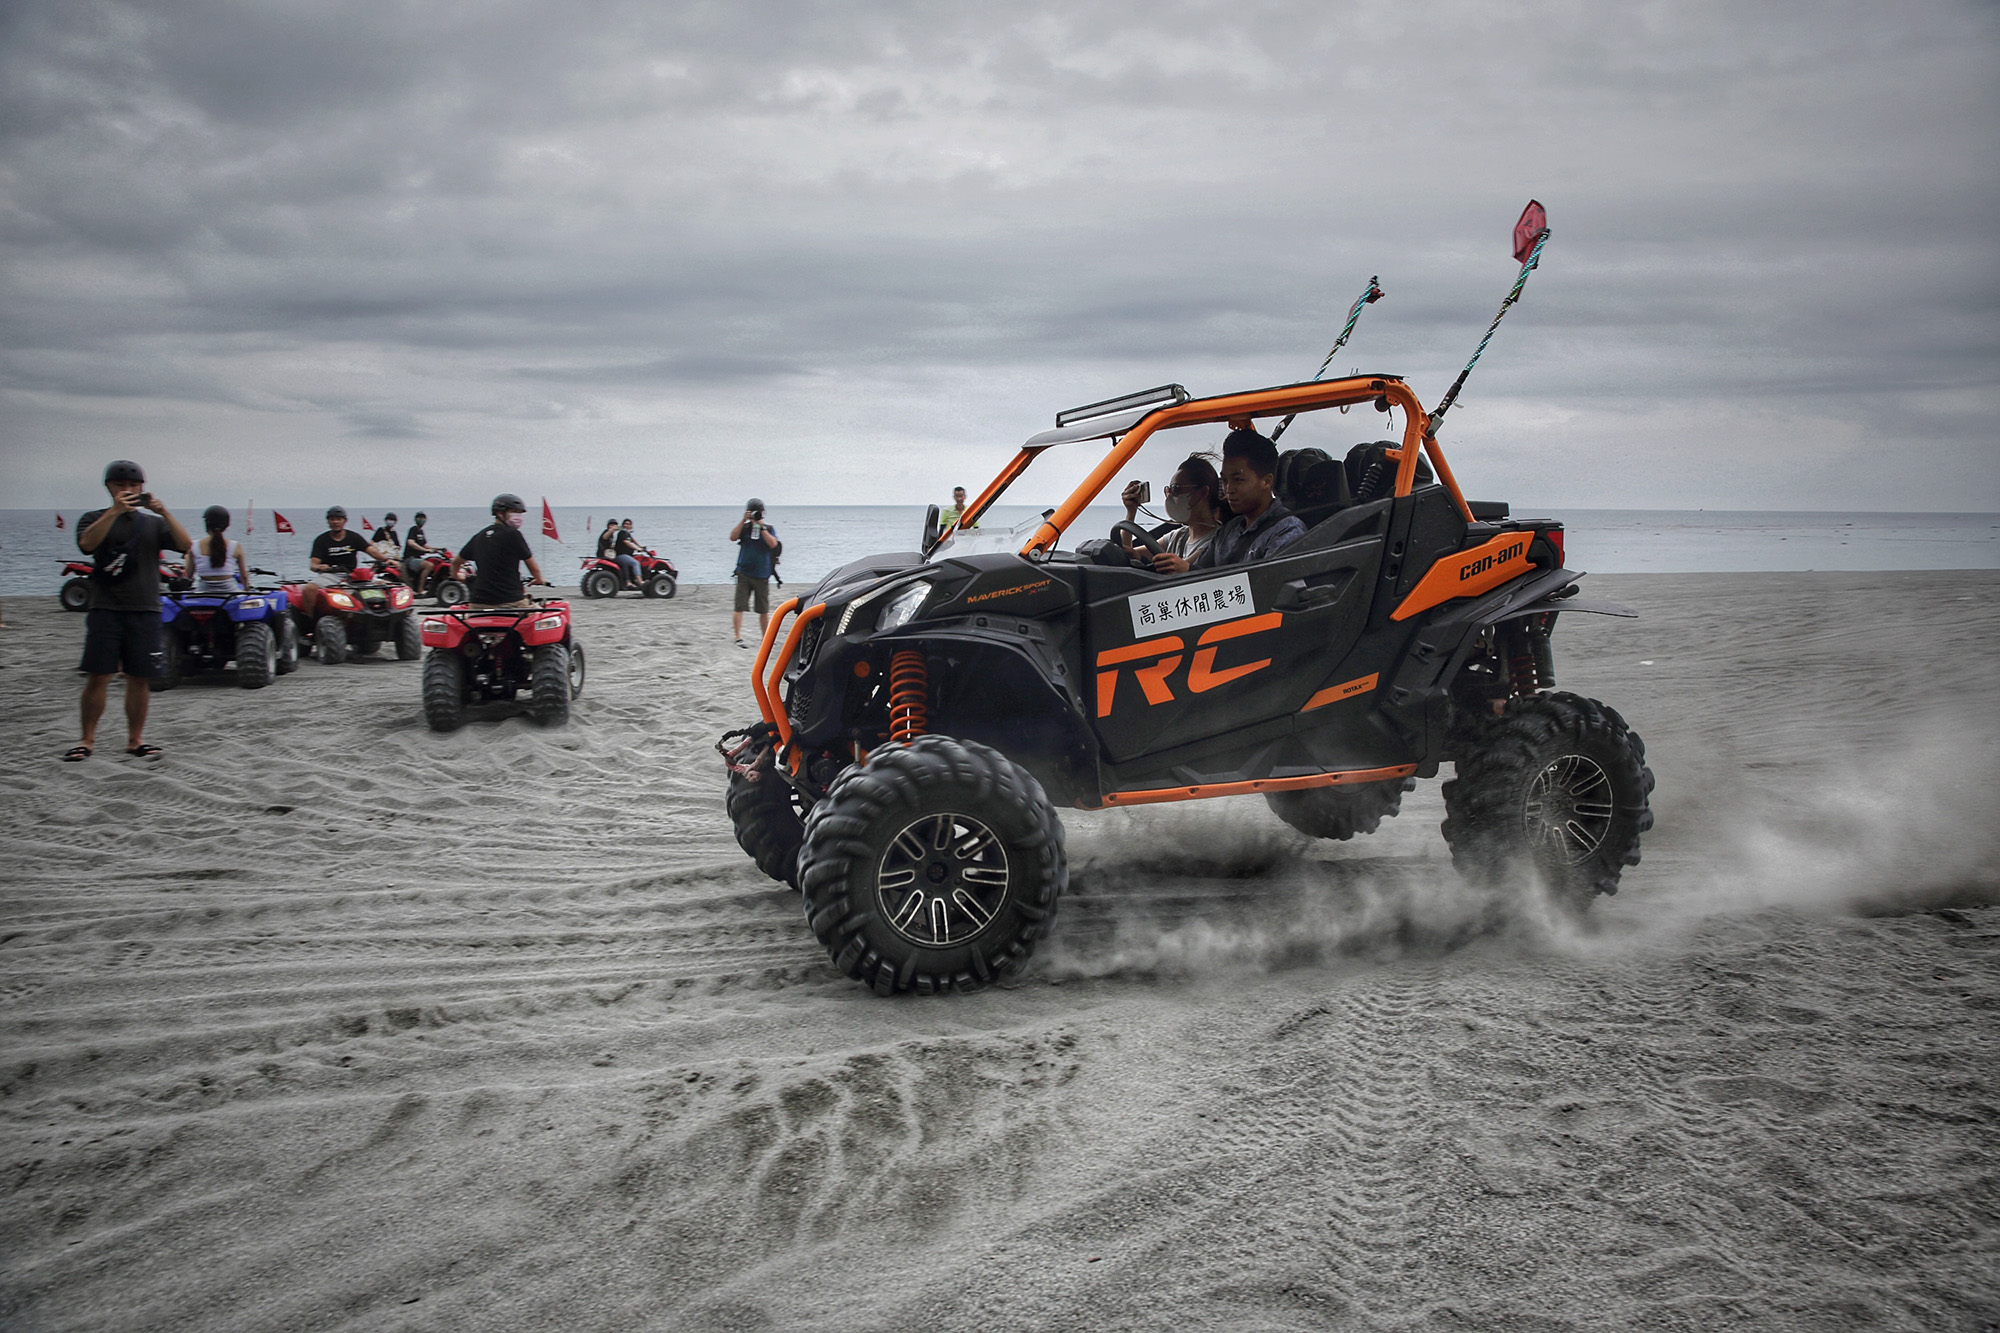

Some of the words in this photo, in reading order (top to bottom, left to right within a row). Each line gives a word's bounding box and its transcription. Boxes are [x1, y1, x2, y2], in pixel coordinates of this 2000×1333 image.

[1460, 541, 1523, 581] can-am
[967, 586, 1023, 604] MAVERICK
[1022, 579, 1051, 590] SPORT
[1138, 585, 1246, 626] 高巢休閒農場
[1096, 612, 1283, 718] RC
[1342, 684, 1362, 694] ROTAX
